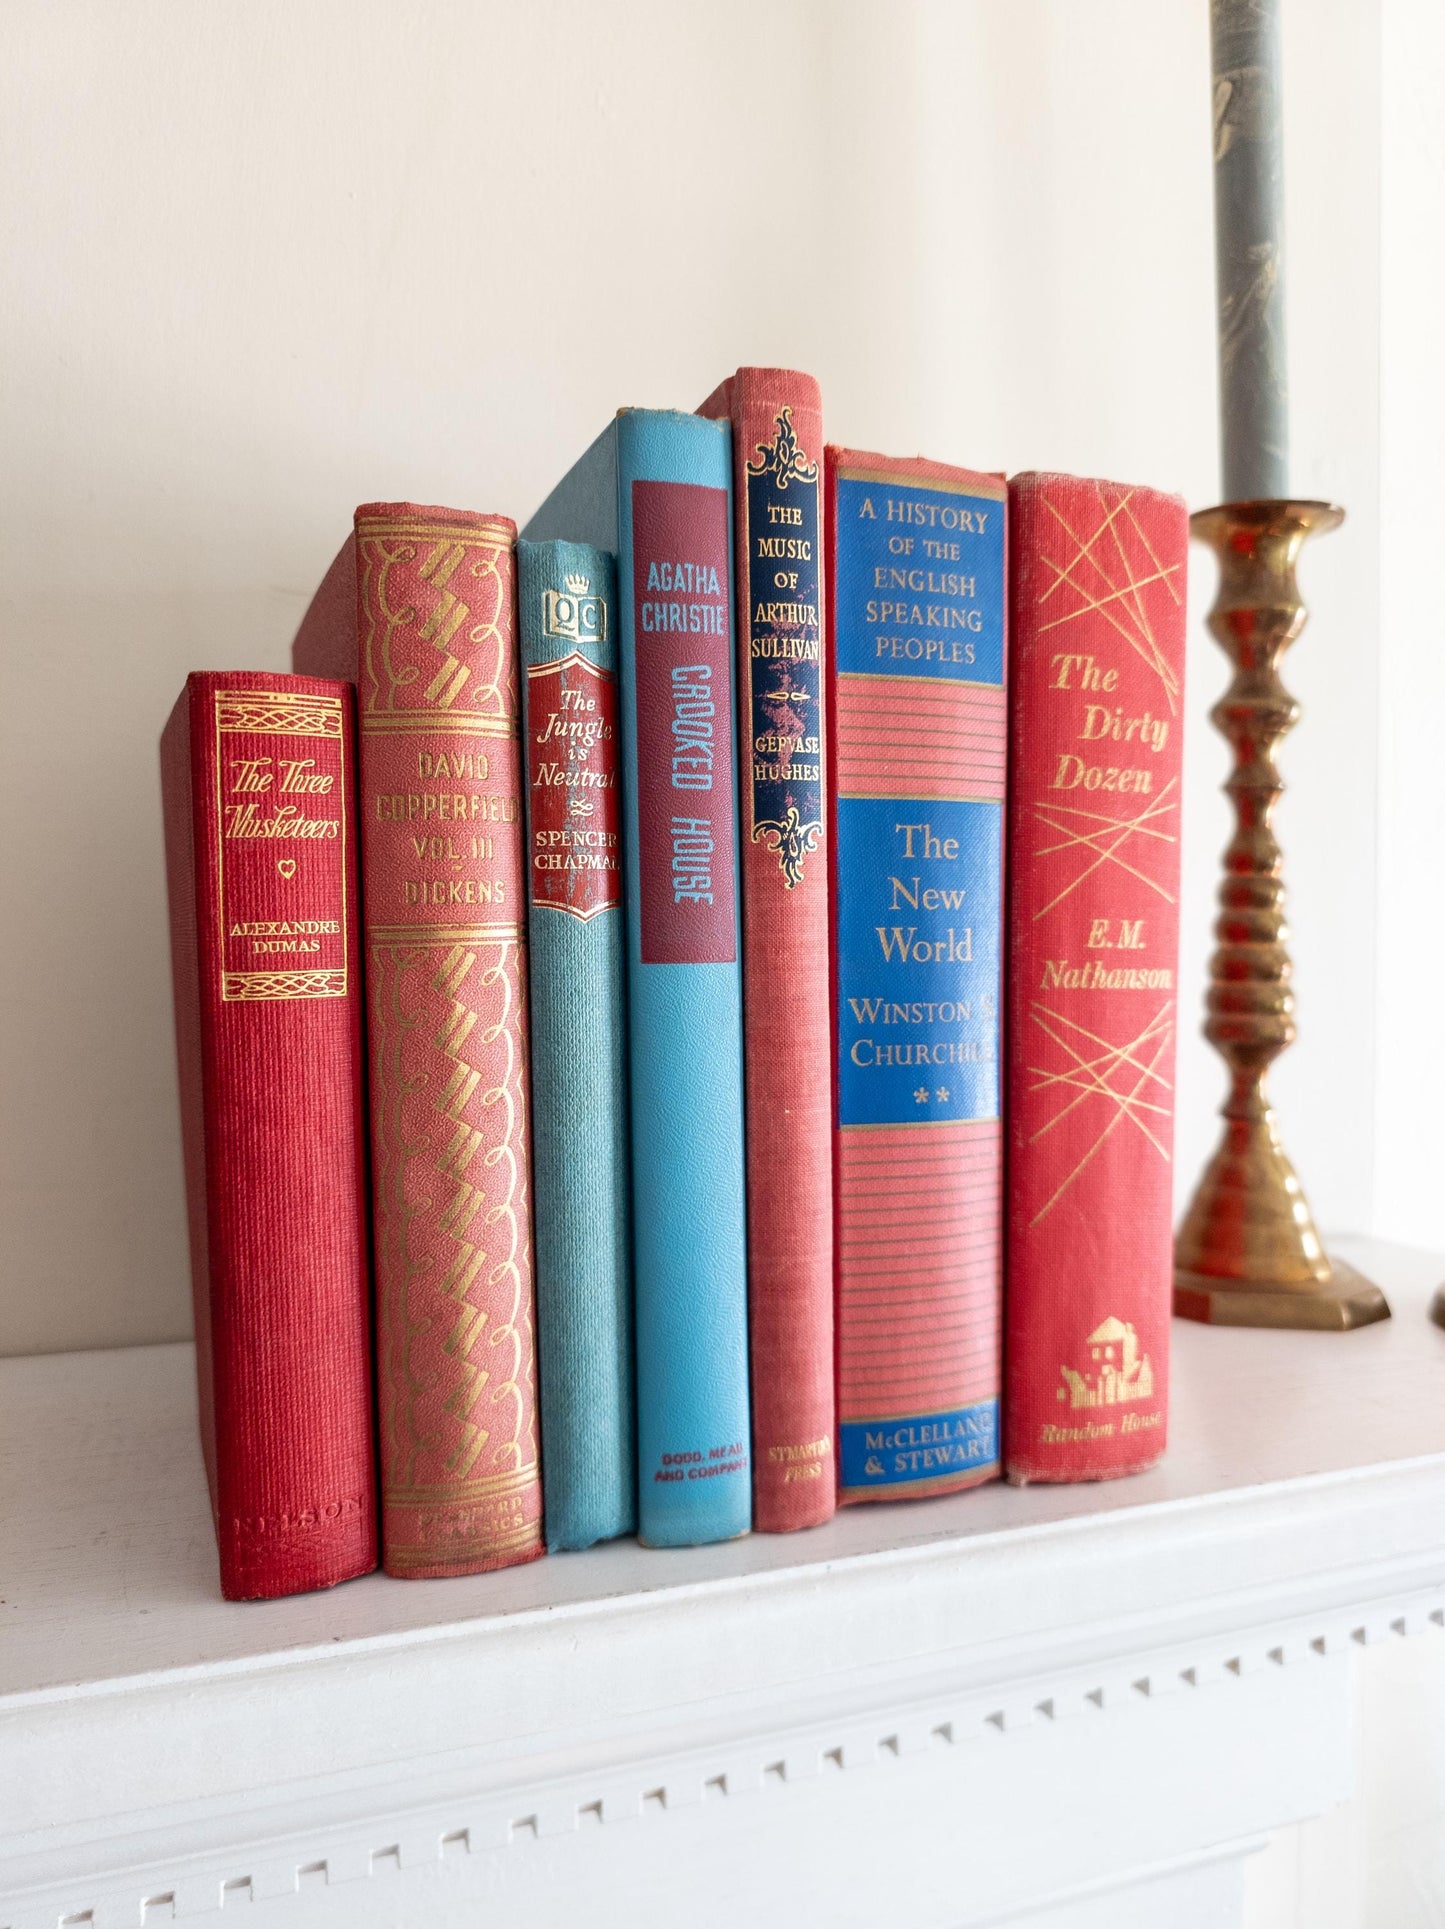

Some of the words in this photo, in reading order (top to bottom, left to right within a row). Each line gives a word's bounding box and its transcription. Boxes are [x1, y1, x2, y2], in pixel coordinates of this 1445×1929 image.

[767, 505, 803, 526] THE
[859, 498, 876, 519] A
[887, 499, 988, 534] HISTORY
[758, 538, 811, 561] MUSIC
[889, 537, 914, 555] OF
[923, 540, 960, 561] THE
[647, 561, 720, 596] AGATHA
[774, 572, 798, 590] OF
[874, 567, 975, 597] ENGLISH
[642, 602, 724, 636] CHRISTIE
[754, 602, 818, 627] ARTHUR
[866, 601, 982, 632] SPEAKING
[752, 638, 819, 661] SULLIVAN
[876, 636, 975, 664] PEOPLES
[1048, 654, 1119, 692] The
[560, 690, 596, 712] The
[537, 713, 612, 747] Jungle
[671, 664, 713, 792] CROOKED
[1078, 704, 1169, 752] Dirty
[568, 740, 588, 761] is
[231, 757, 273, 793] The
[279, 759, 334, 794] Three
[419, 752, 489, 780] DAVID
[754, 763, 819, 781] HUGHES
[1048, 755, 1151, 794] Dozen
[225, 804, 340, 839] Musketeers
[413, 837, 467, 859] VOL.
[472, 837, 494, 859] III
[535, 830, 618, 848] SPENCER
[896, 824, 959, 859] The
[670, 815, 714, 906] HOUSE
[405, 881, 505, 904] DICKENS
[888, 877, 966, 910] New
[230, 920, 340, 936] ALEXANDRE
[253, 940, 320, 954] DUMAS
[876, 927, 974, 962] World
[1040, 960, 1172, 990] Nathanson
[1040, 1422, 1113, 1443] Random
[1121, 1411, 1161, 1433] House
[865, 1456, 885, 1475] &
[895, 1435, 989, 1472] STEWART
[655, 1469, 684, 1483] AND
